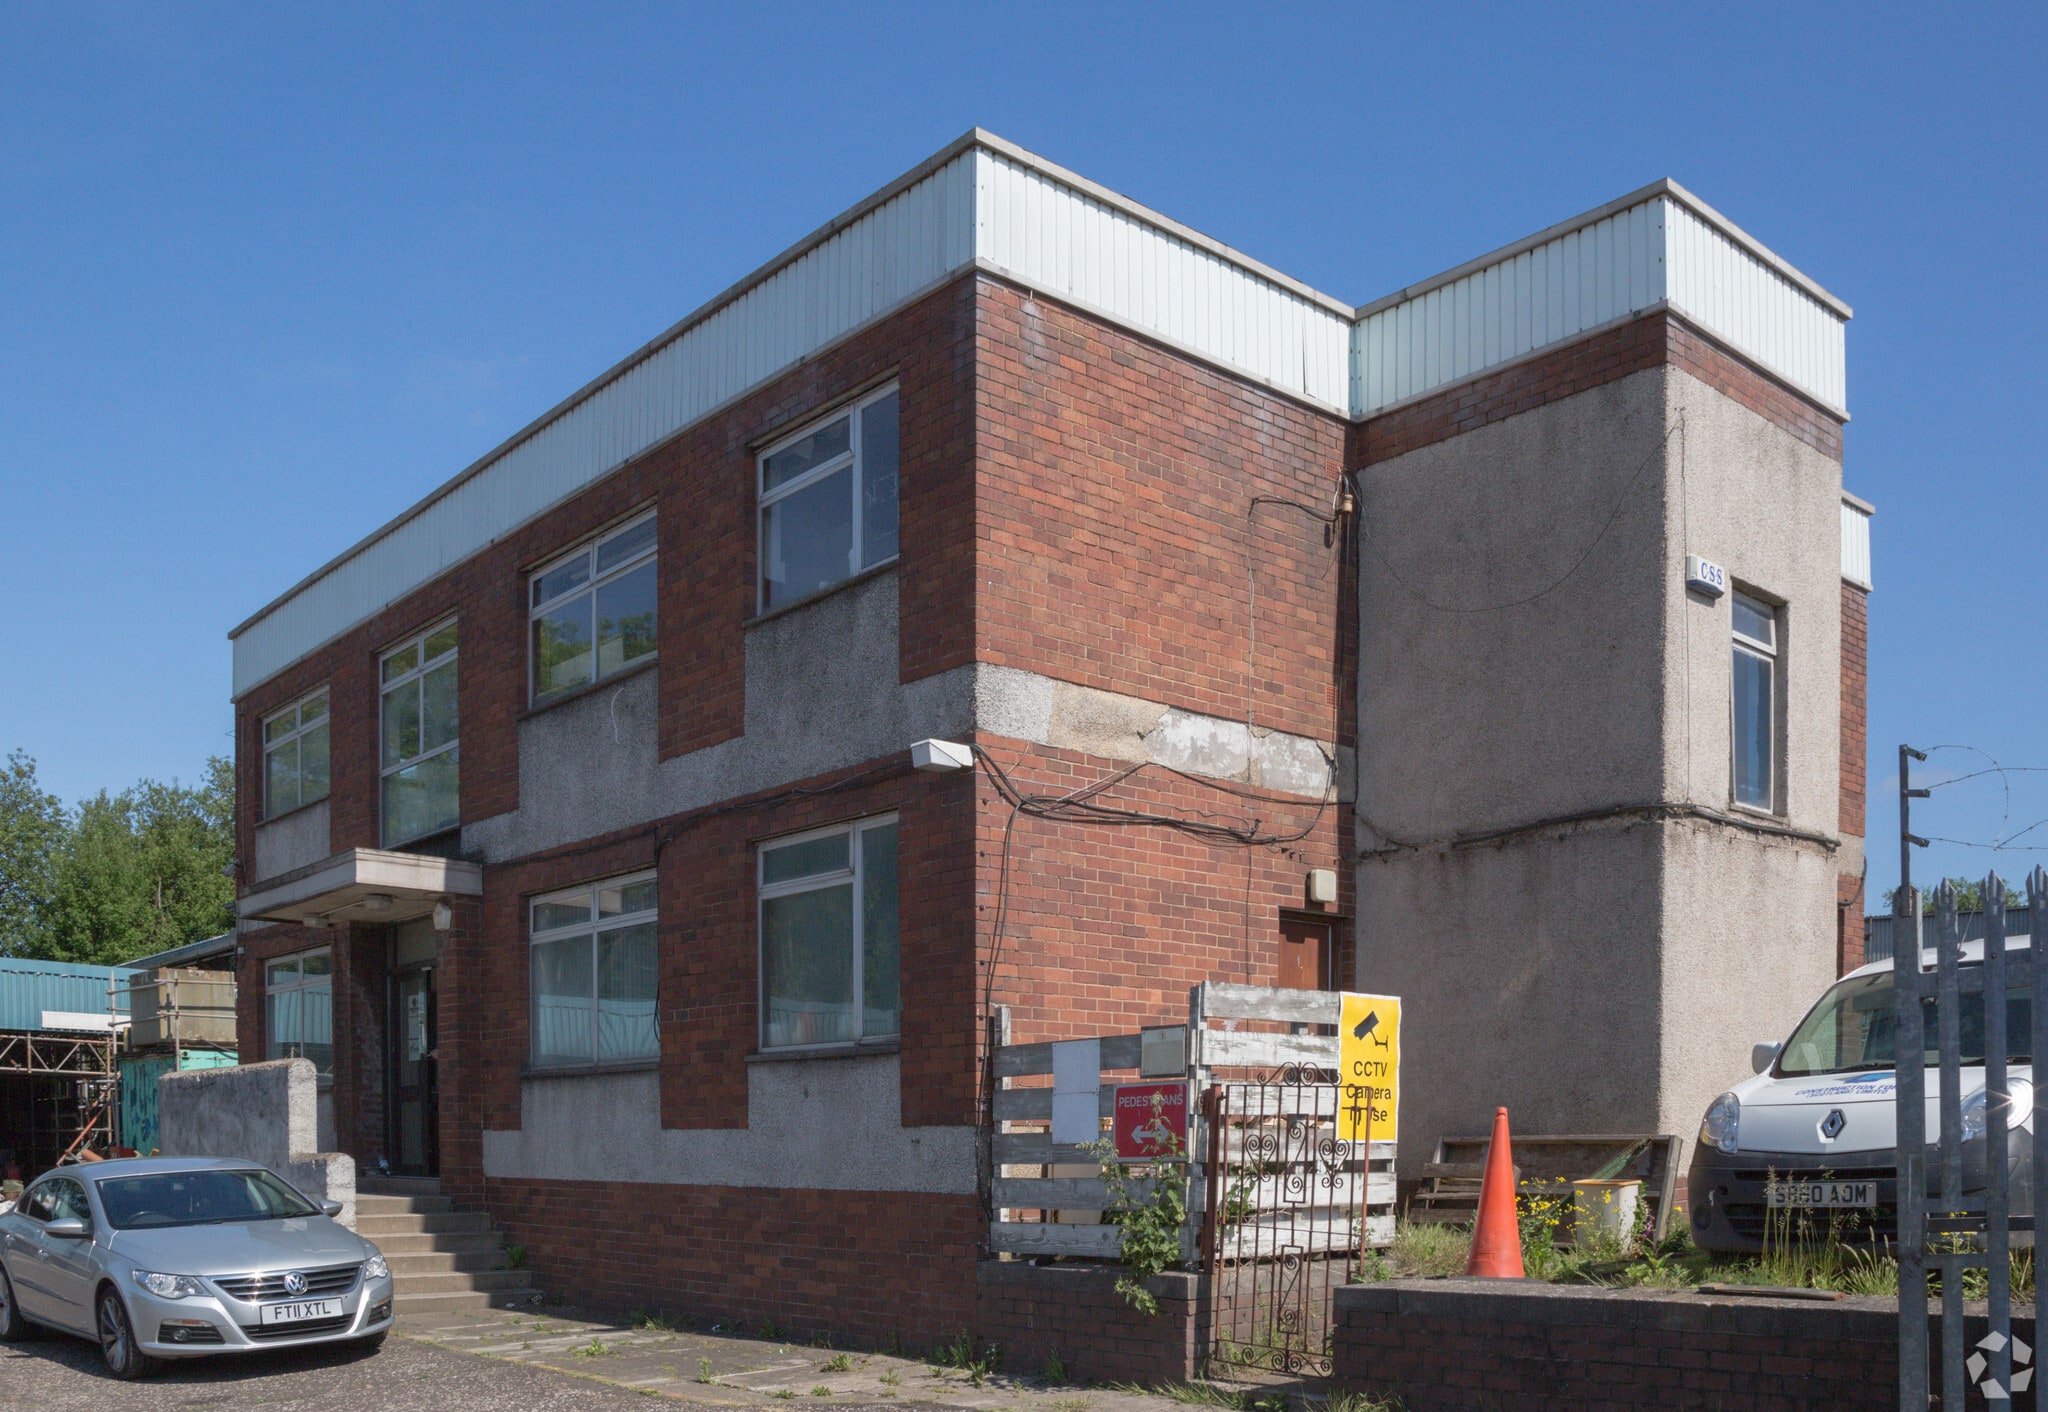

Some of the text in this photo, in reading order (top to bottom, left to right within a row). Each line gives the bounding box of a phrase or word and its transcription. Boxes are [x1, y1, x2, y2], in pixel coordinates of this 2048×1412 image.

[1353, 1061, 1388, 1077] CCTV
[1118, 1094, 1183, 1108] PEDESTANS
[1366, 1107, 1388, 1122] se
[304, 1302, 331, 1317] XTL
